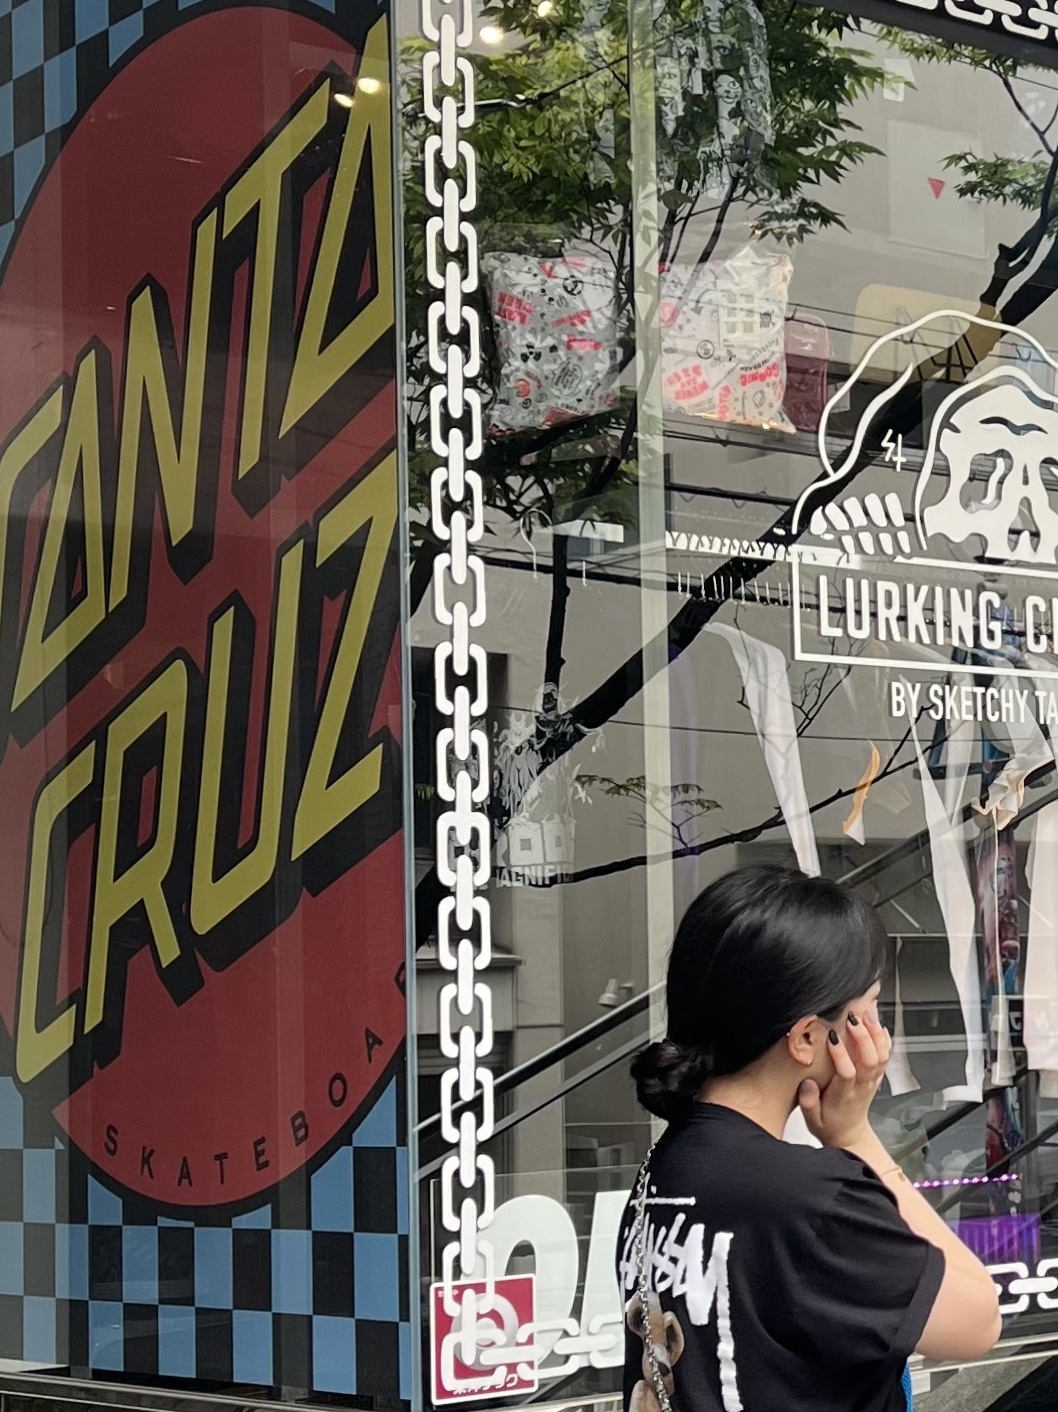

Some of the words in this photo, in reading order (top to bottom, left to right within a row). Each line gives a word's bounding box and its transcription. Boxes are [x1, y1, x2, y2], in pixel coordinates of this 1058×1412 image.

[819, 575, 1001, 649] LURKING
[891, 682, 920, 718] BY
[929, 684, 1029, 723] SKETCHY
[15, 449, 397, 1083] CRUZ
